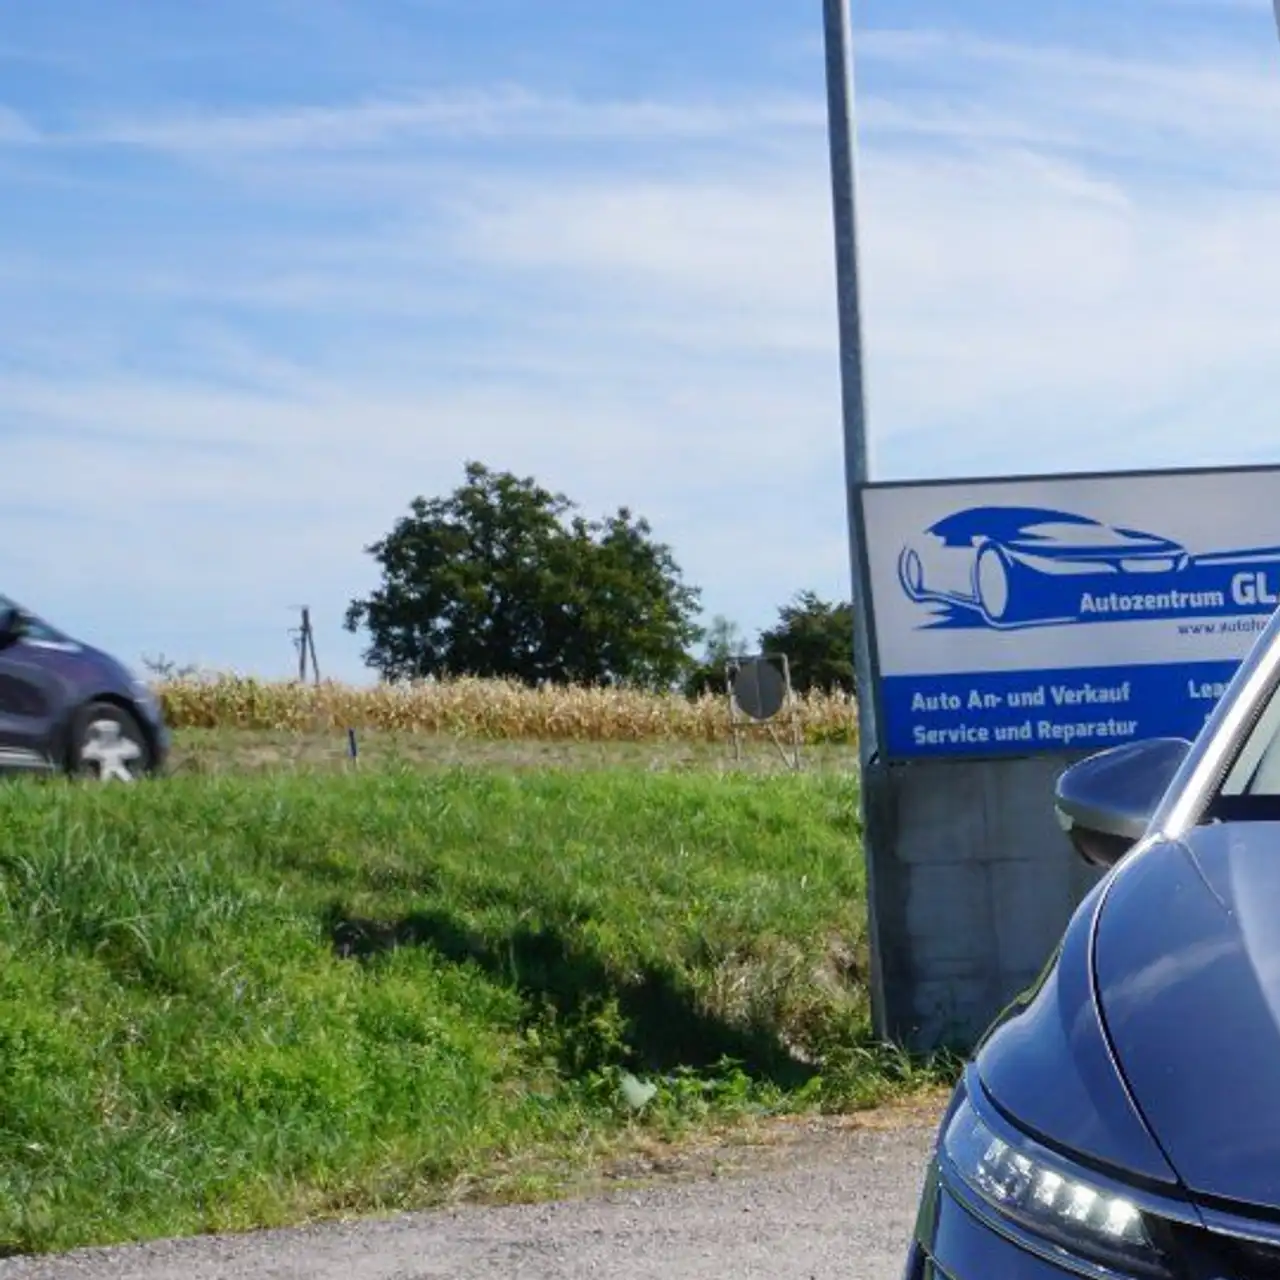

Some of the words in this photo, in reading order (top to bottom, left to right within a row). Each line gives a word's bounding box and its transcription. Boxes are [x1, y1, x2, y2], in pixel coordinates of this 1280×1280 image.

[1080, 590, 1225, 613] Autozentrum
[911, 692, 961, 712] Auto
[967, 689, 1002, 709] An-
[1007, 685, 1045, 707] und
[1051, 681, 1131, 705] Verkauf
[912, 724, 989, 745] Service
[995, 720, 1032, 742] und
[1038, 718, 1138, 744] Reparatur
